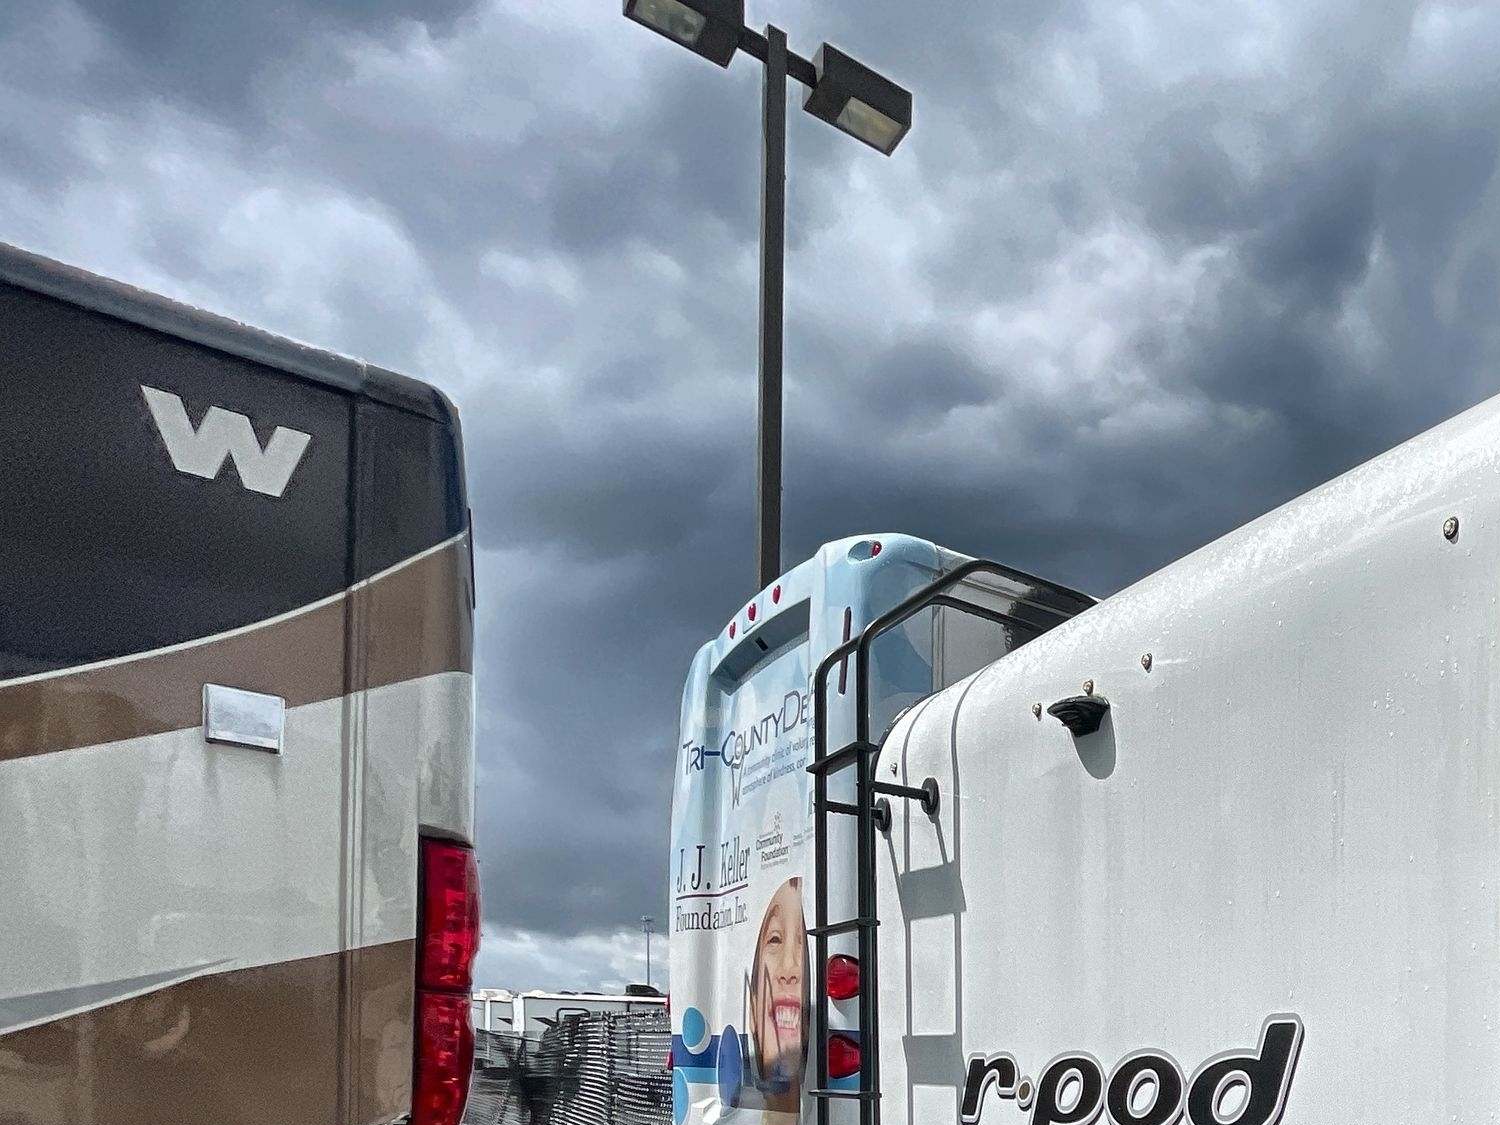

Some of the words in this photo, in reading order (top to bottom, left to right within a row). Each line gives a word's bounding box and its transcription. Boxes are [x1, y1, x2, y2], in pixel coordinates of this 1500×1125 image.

[141, 385, 312, 498] W
[691, 845, 711, 890] J.
[720, 836, 750, 888] Keller
